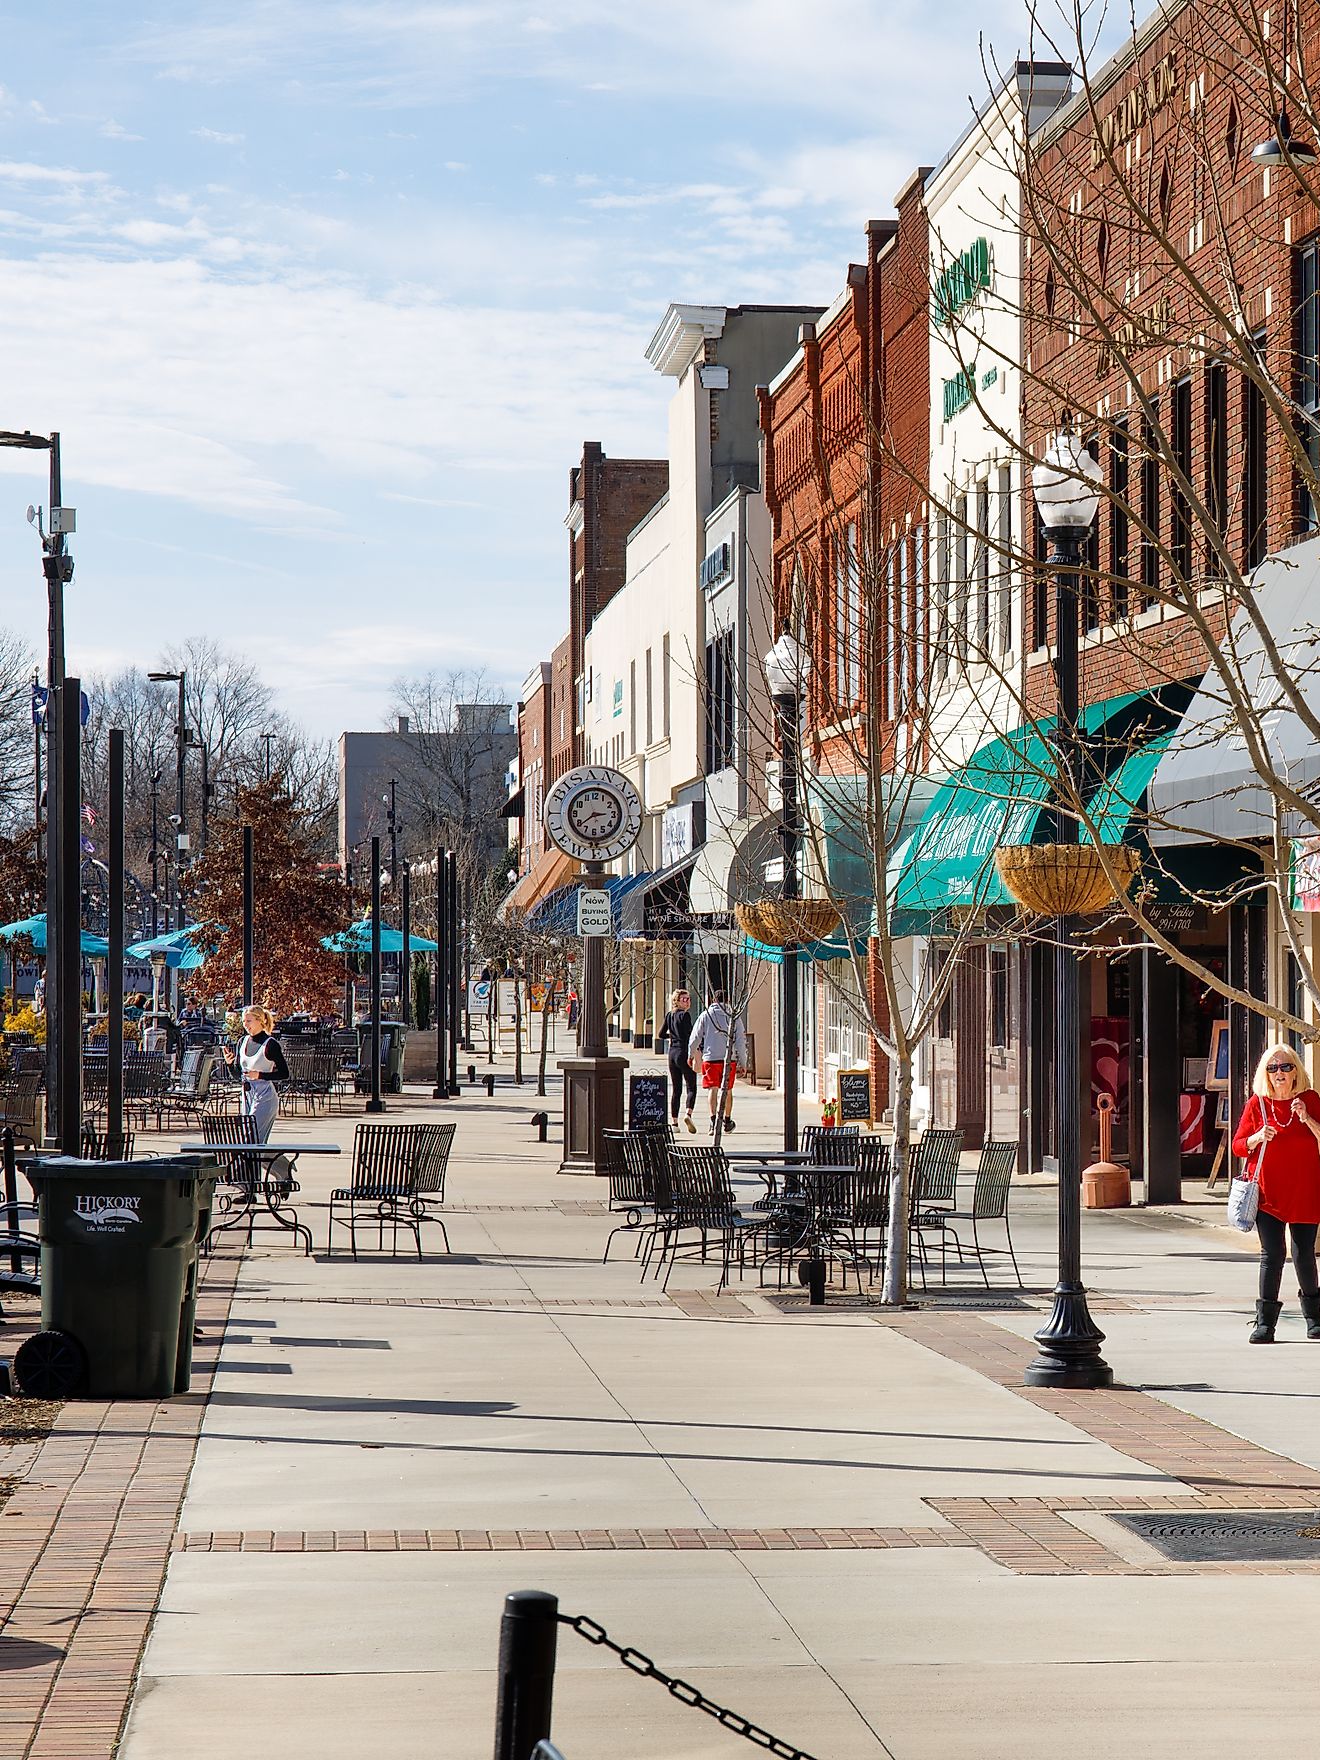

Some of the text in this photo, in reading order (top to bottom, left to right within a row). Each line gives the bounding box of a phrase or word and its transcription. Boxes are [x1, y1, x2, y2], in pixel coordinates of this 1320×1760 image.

[554, 769, 639, 807] BISANAR
[584, 794, 590, 802] 11
[592, 792, 599, 801] 12
[576, 801, 583, 809] 10
[607, 820, 613, 828] 4
[550, 821, 640, 860] JEWELER
[586, 897, 605, 905] NOW
[1149, 905, 1195, 920] by Teiko
[582, 917, 609, 926] GOLD
[1158, 919, 1191, 930] 291-1703
[76, 1196, 141, 1212] HICKORY
